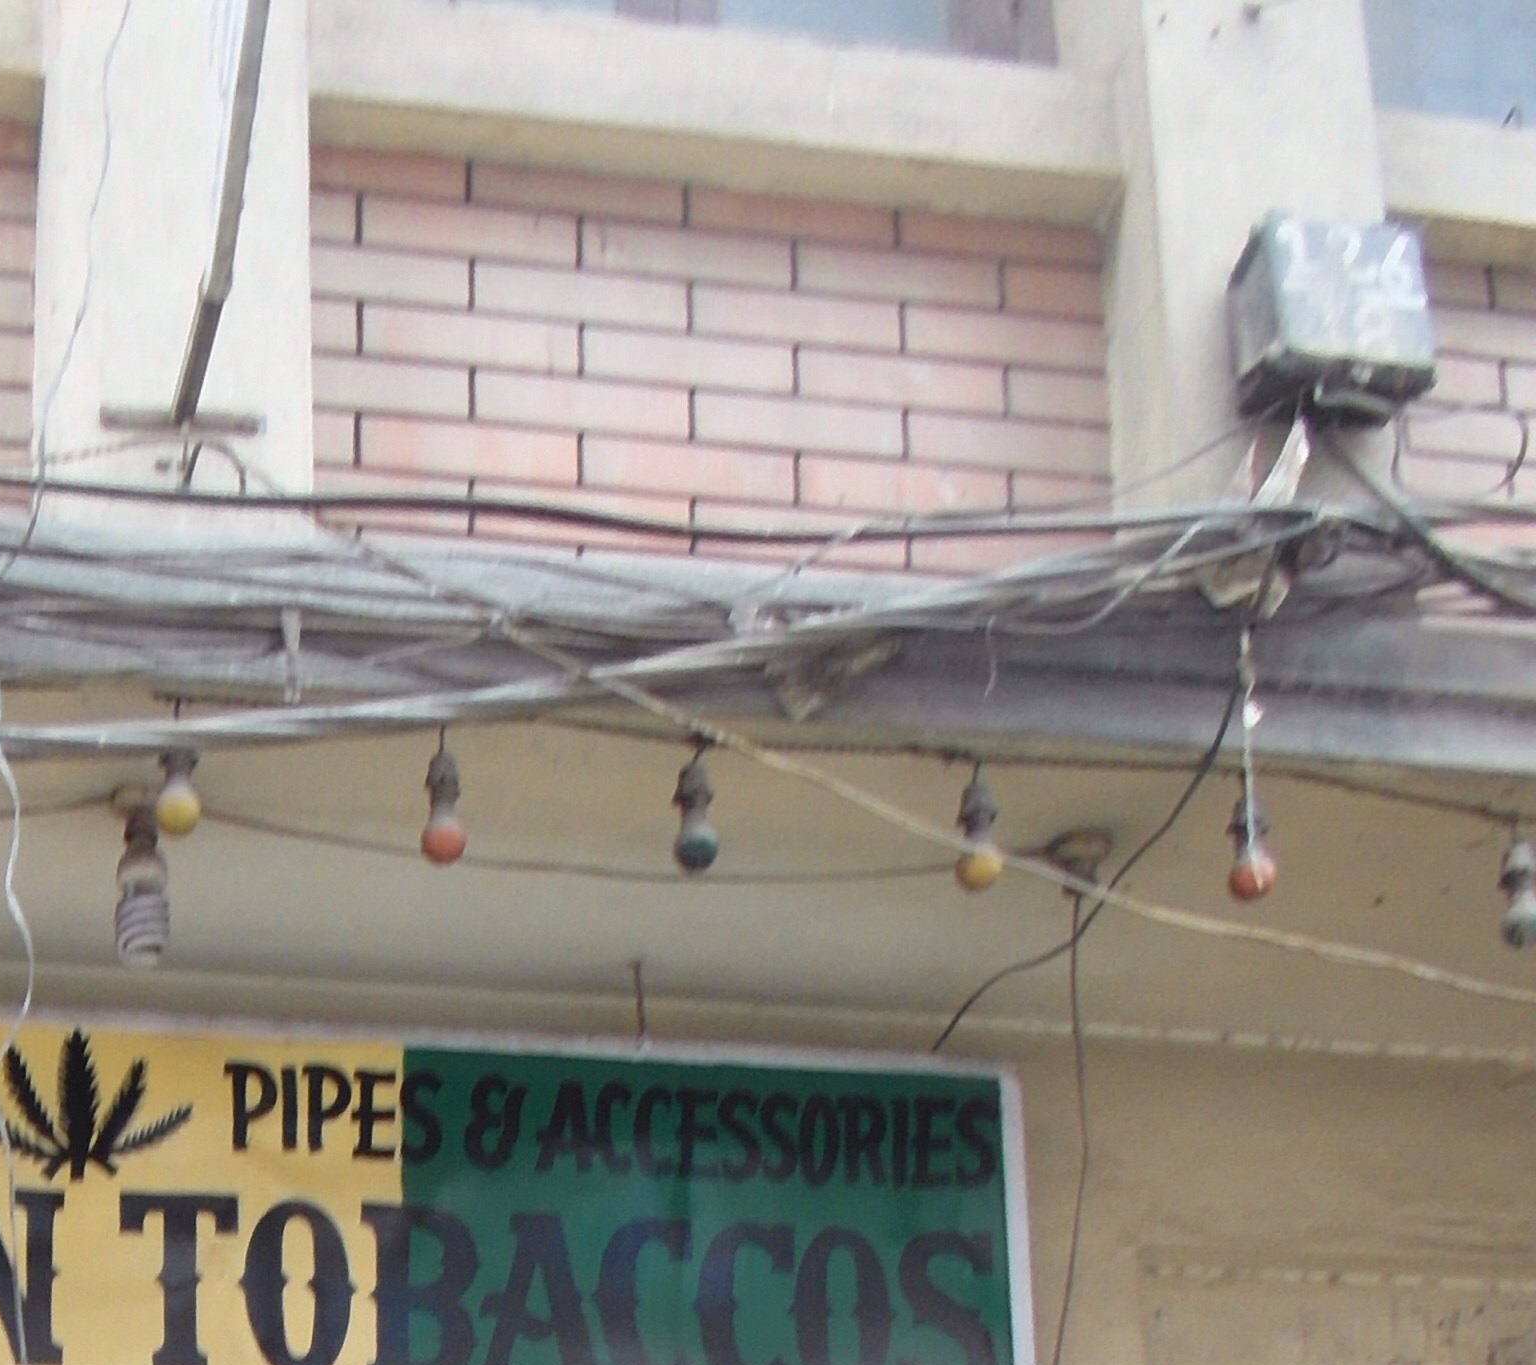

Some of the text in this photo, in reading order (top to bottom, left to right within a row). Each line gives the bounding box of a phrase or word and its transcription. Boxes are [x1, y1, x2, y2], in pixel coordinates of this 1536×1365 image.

[224, 1060, 444, 1166] PIPES
[464, 1072, 528, 1174] &
[532, 1080, 1001, 1190] ACCESSORIES
